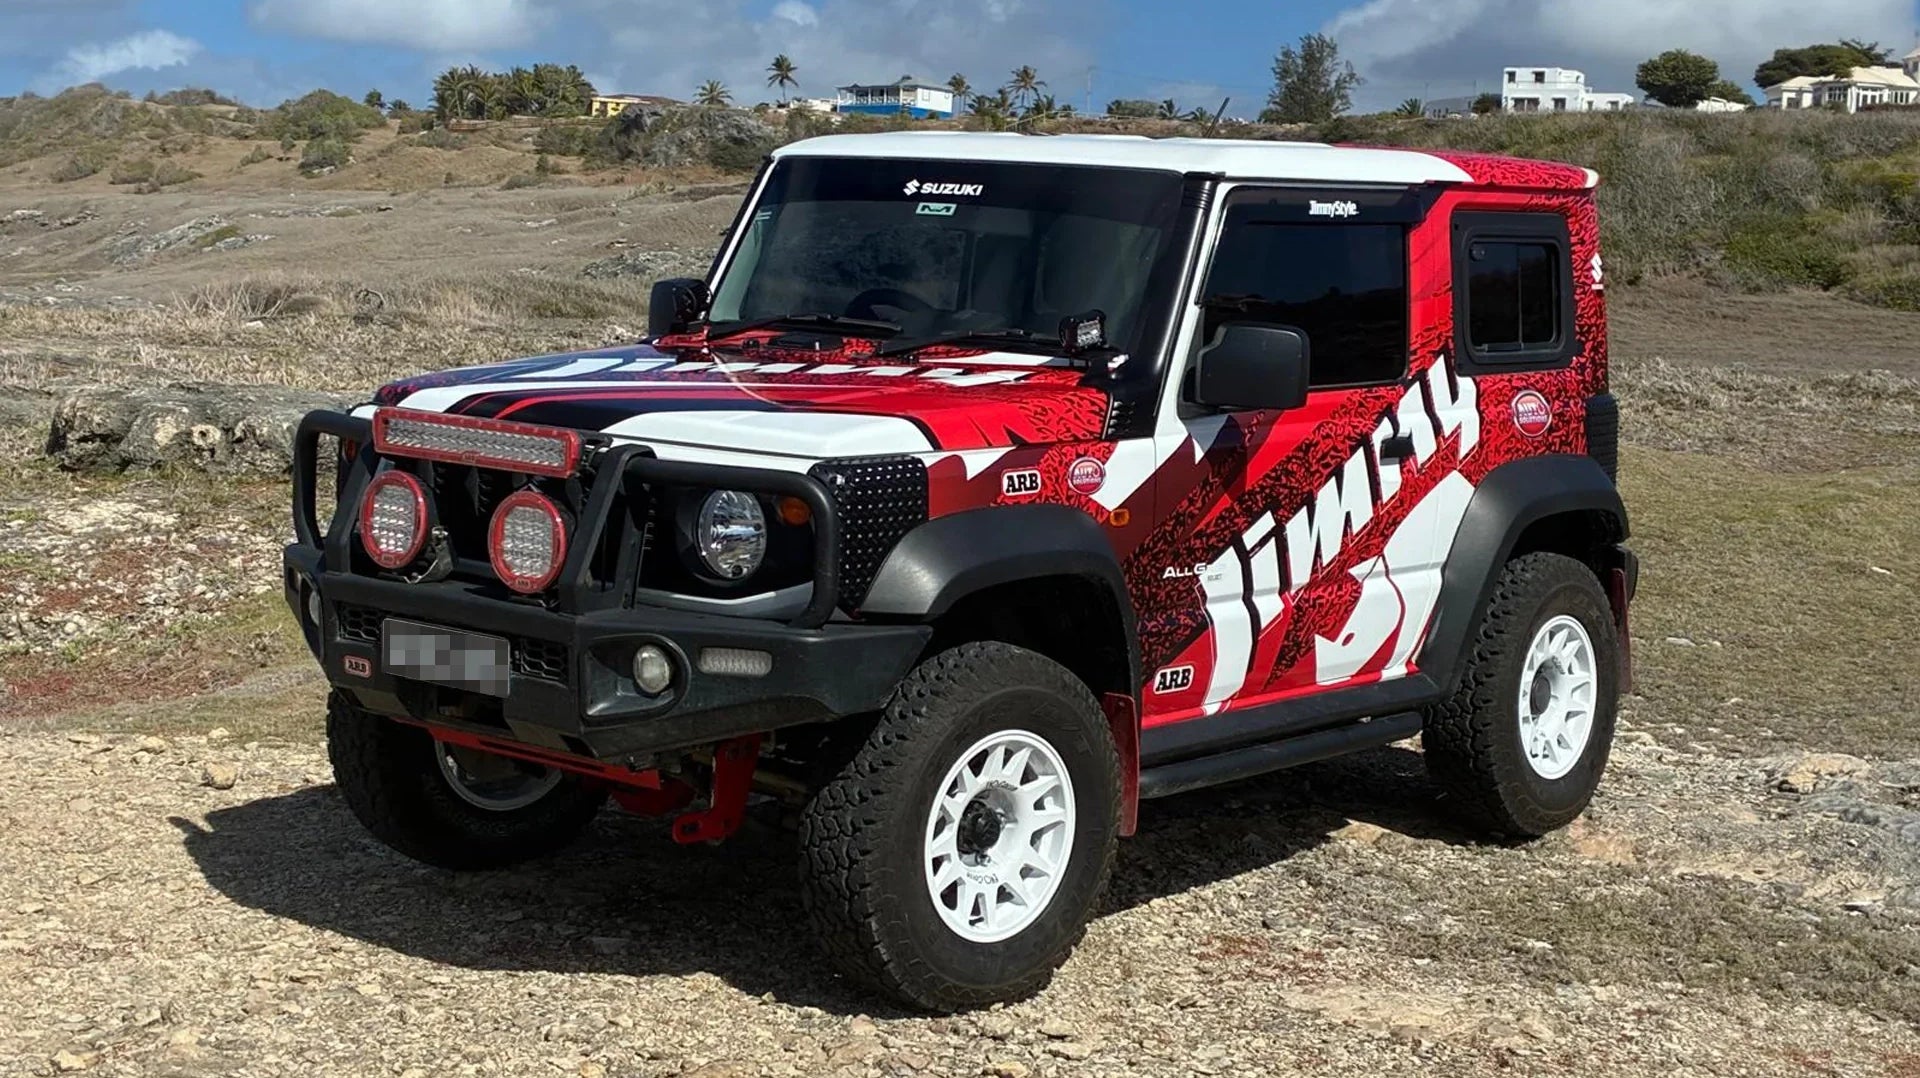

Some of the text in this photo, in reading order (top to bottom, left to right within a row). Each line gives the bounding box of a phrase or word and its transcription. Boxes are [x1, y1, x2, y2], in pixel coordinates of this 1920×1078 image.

[920, 183, 984, 196] SUZUKI
[1309, 200, 1358, 218] JimnyStyle
[1517, 402, 1546, 415] AUTO
[1073, 466, 1101, 478] AUTO
[1005, 472, 1039, 494] ARB
[1156, 668, 1191, 692] ARB
